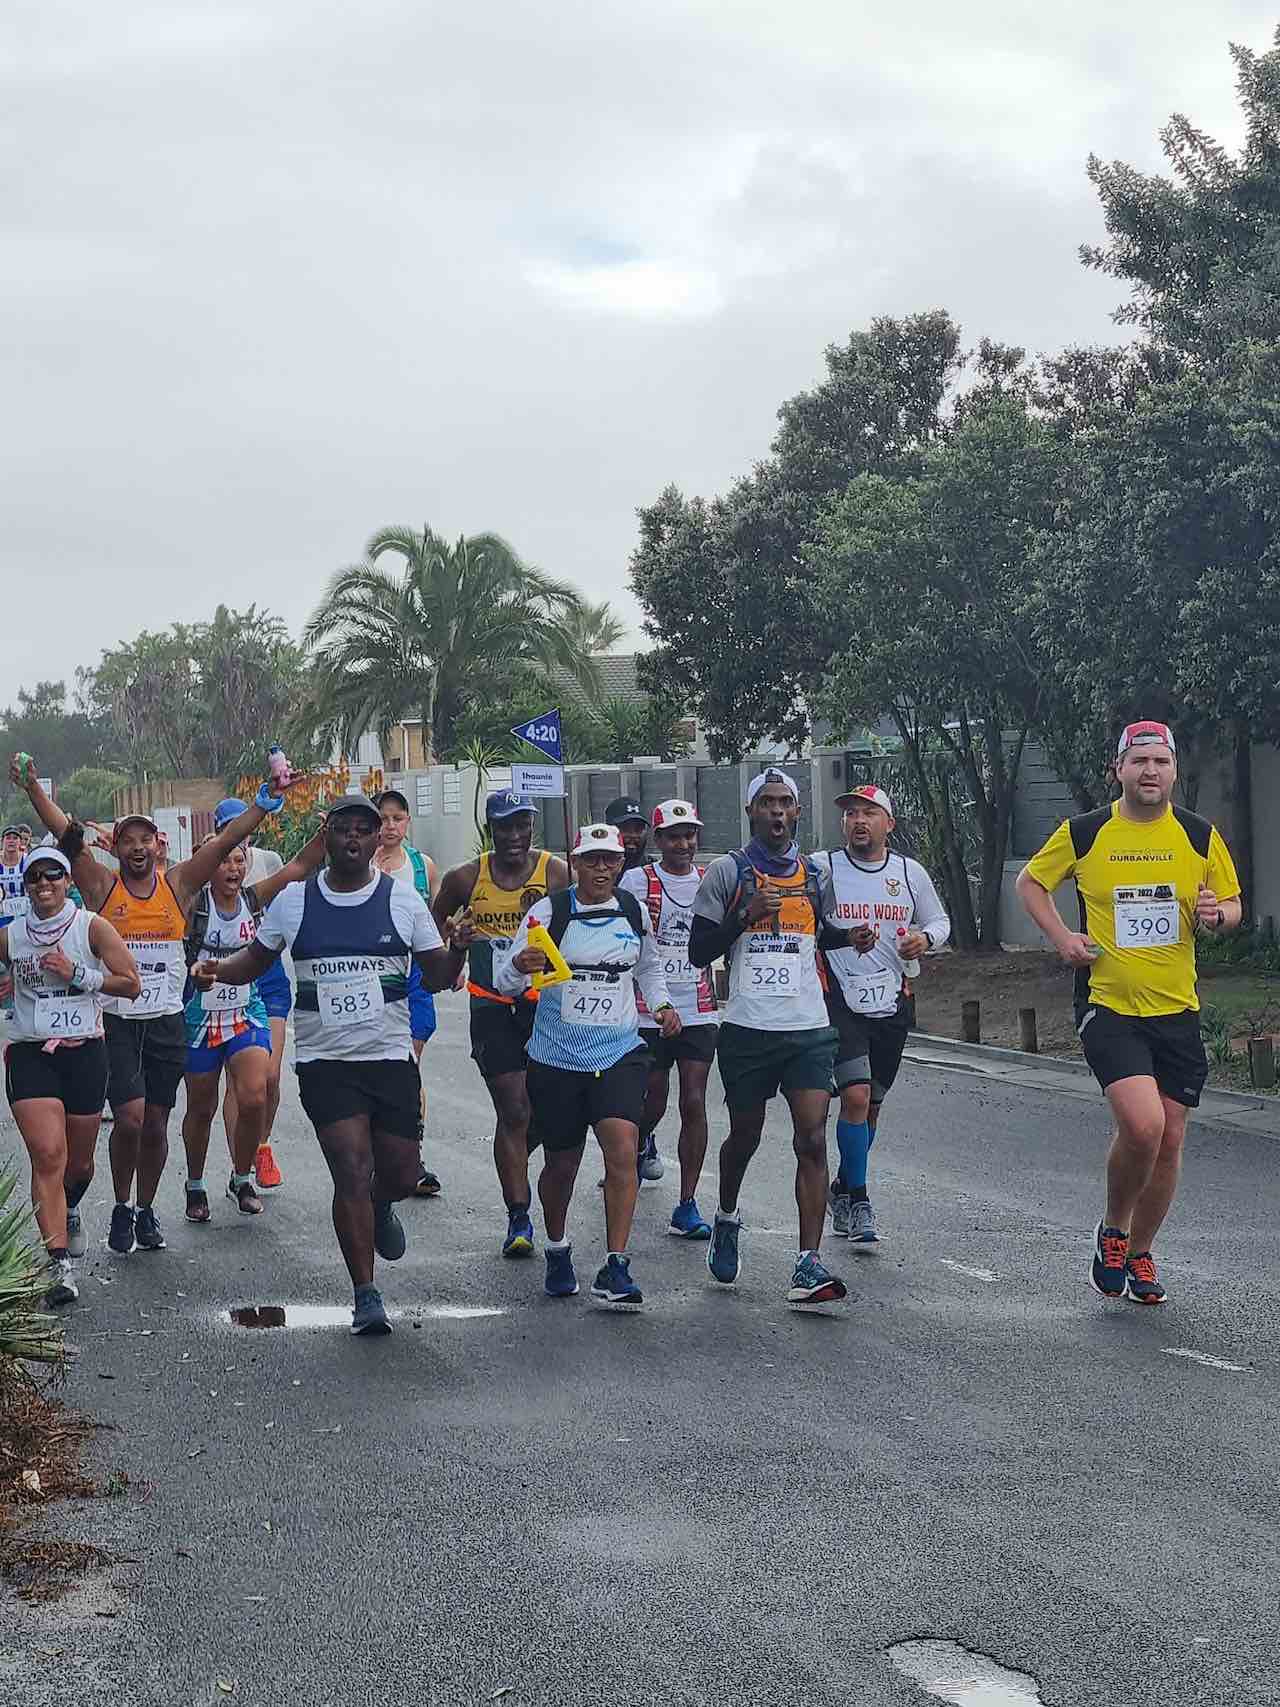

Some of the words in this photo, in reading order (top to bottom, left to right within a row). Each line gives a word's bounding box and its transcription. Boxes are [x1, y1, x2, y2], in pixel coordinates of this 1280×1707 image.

[525, 723, 558, 742] 4:20
[1127, 917, 1169, 936] 390
[311, 959, 386, 977] FOURWAYS
[664, 959, 695, 974] 614
[751, 967, 791, 985] 328
[131, 985, 162, 1005] 97
[216, 986, 238, 1001] 48
[857, 985, 887, 1004] 217
[330, 992, 371, 1016] 583
[573, 996, 613, 1016] 479
[50, 1009, 82, 1029] 216
